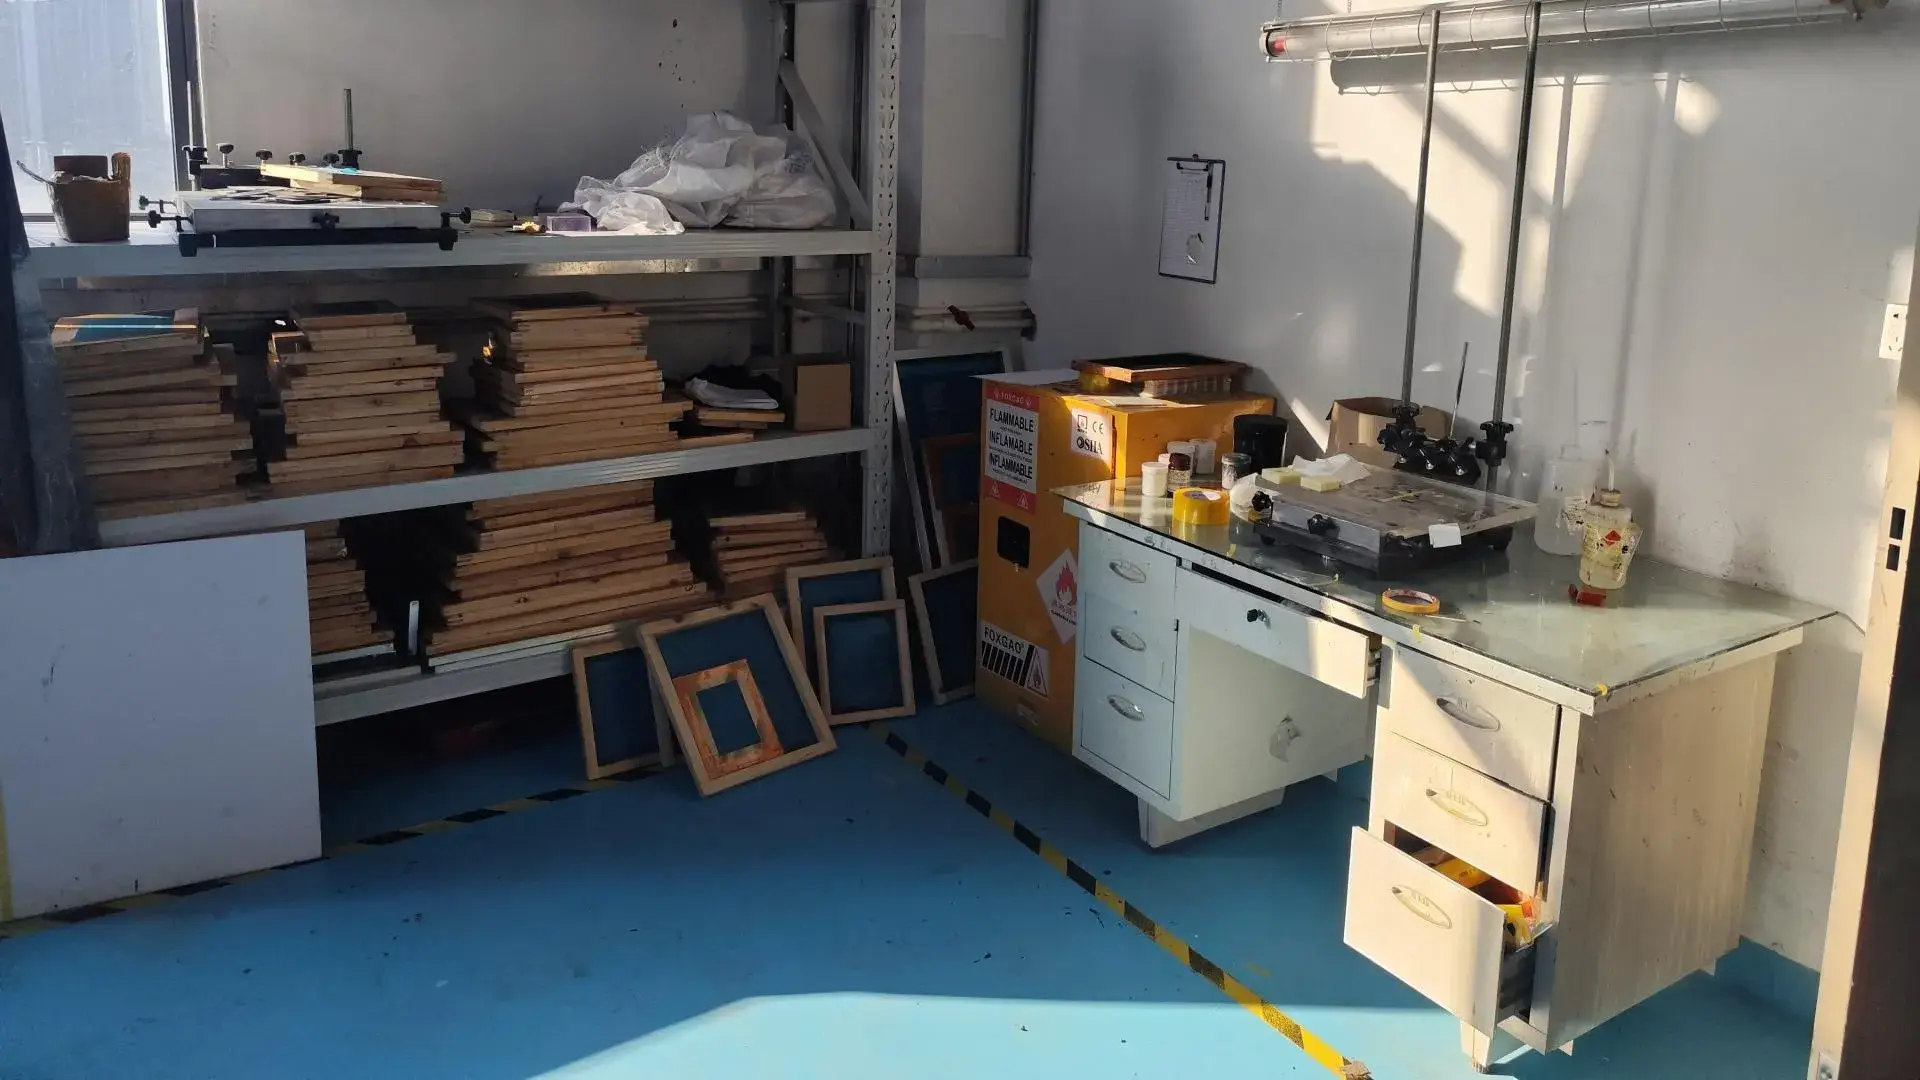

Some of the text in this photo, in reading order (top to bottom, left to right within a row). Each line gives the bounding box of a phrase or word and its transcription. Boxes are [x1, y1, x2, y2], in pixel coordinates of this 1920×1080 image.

[989, 408, 1034, 433] FLAMMABLE
[1092, 421, 1104, 435] CE
[989, 430, 1033, 455] INFLAMABLE
[1076, 436, 1103, 455] OSHA
[988, 452, 1033, 479] INFLAMMABLE
[984, 626, 1021, 654] FOXGAO
